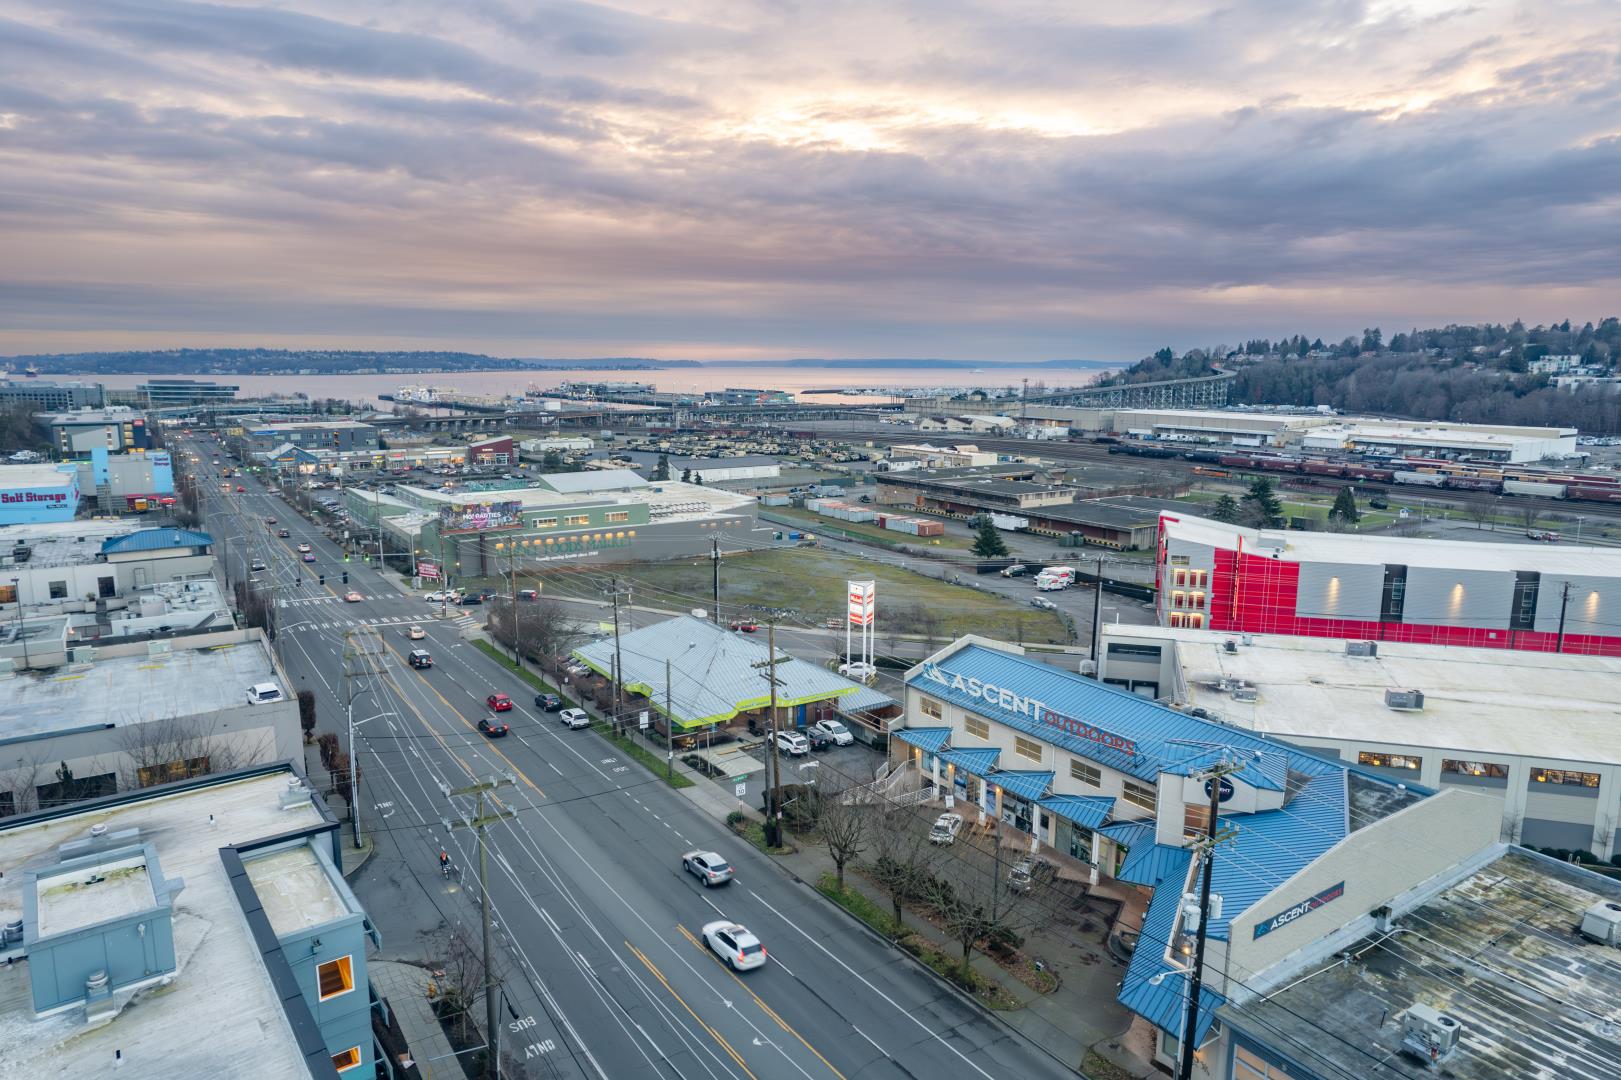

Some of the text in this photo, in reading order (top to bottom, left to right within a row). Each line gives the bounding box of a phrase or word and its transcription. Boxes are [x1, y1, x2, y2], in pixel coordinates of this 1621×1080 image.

[1, 492, 66, 503] Self Storage
[544, 538, 584, 554] FOODS
[951, 673, 1136, 757] ASCENT OUTDOORS
[1270, 901, 1311, 930] ASCENT
[509, 1016, 537, 1033] BUS
[524, 1039, 556, 1060] ONLY
